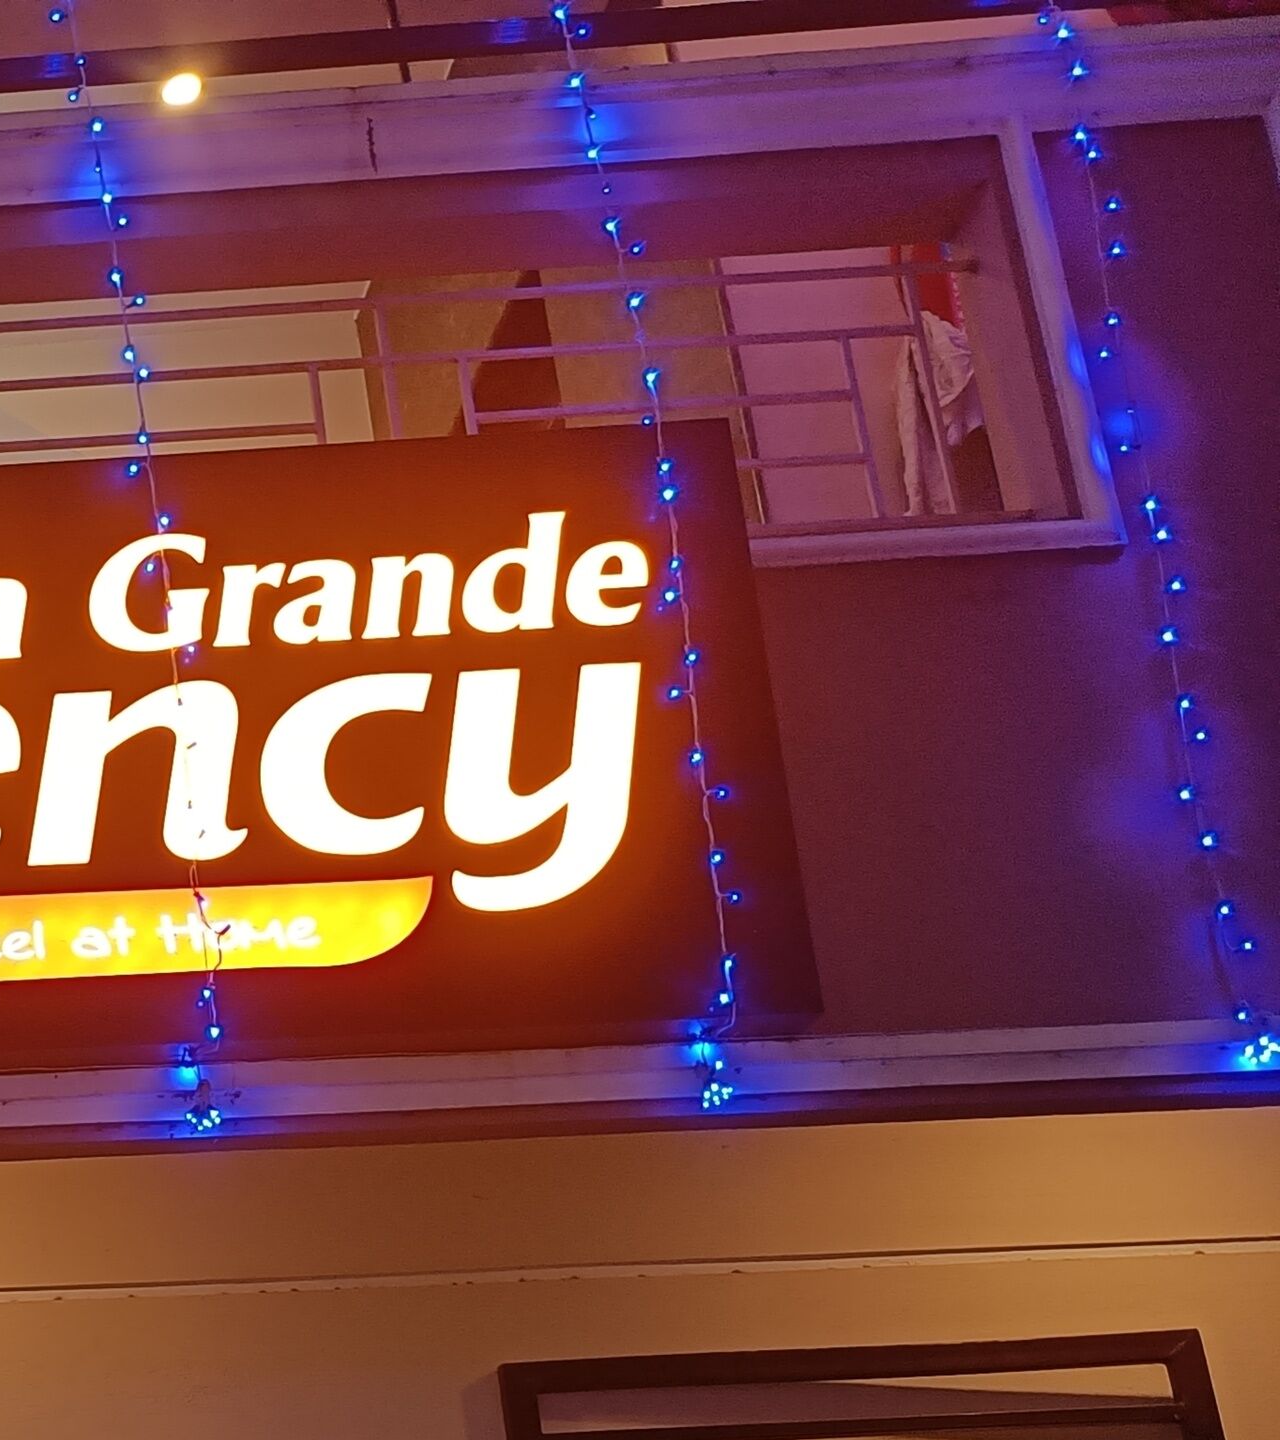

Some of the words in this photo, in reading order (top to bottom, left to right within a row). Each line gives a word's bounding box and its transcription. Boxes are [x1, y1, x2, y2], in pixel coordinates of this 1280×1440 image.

[88, 511, 650, 656] Grande
[71, 914, 136, 958] at
[157, 912, 322, 955] Home
